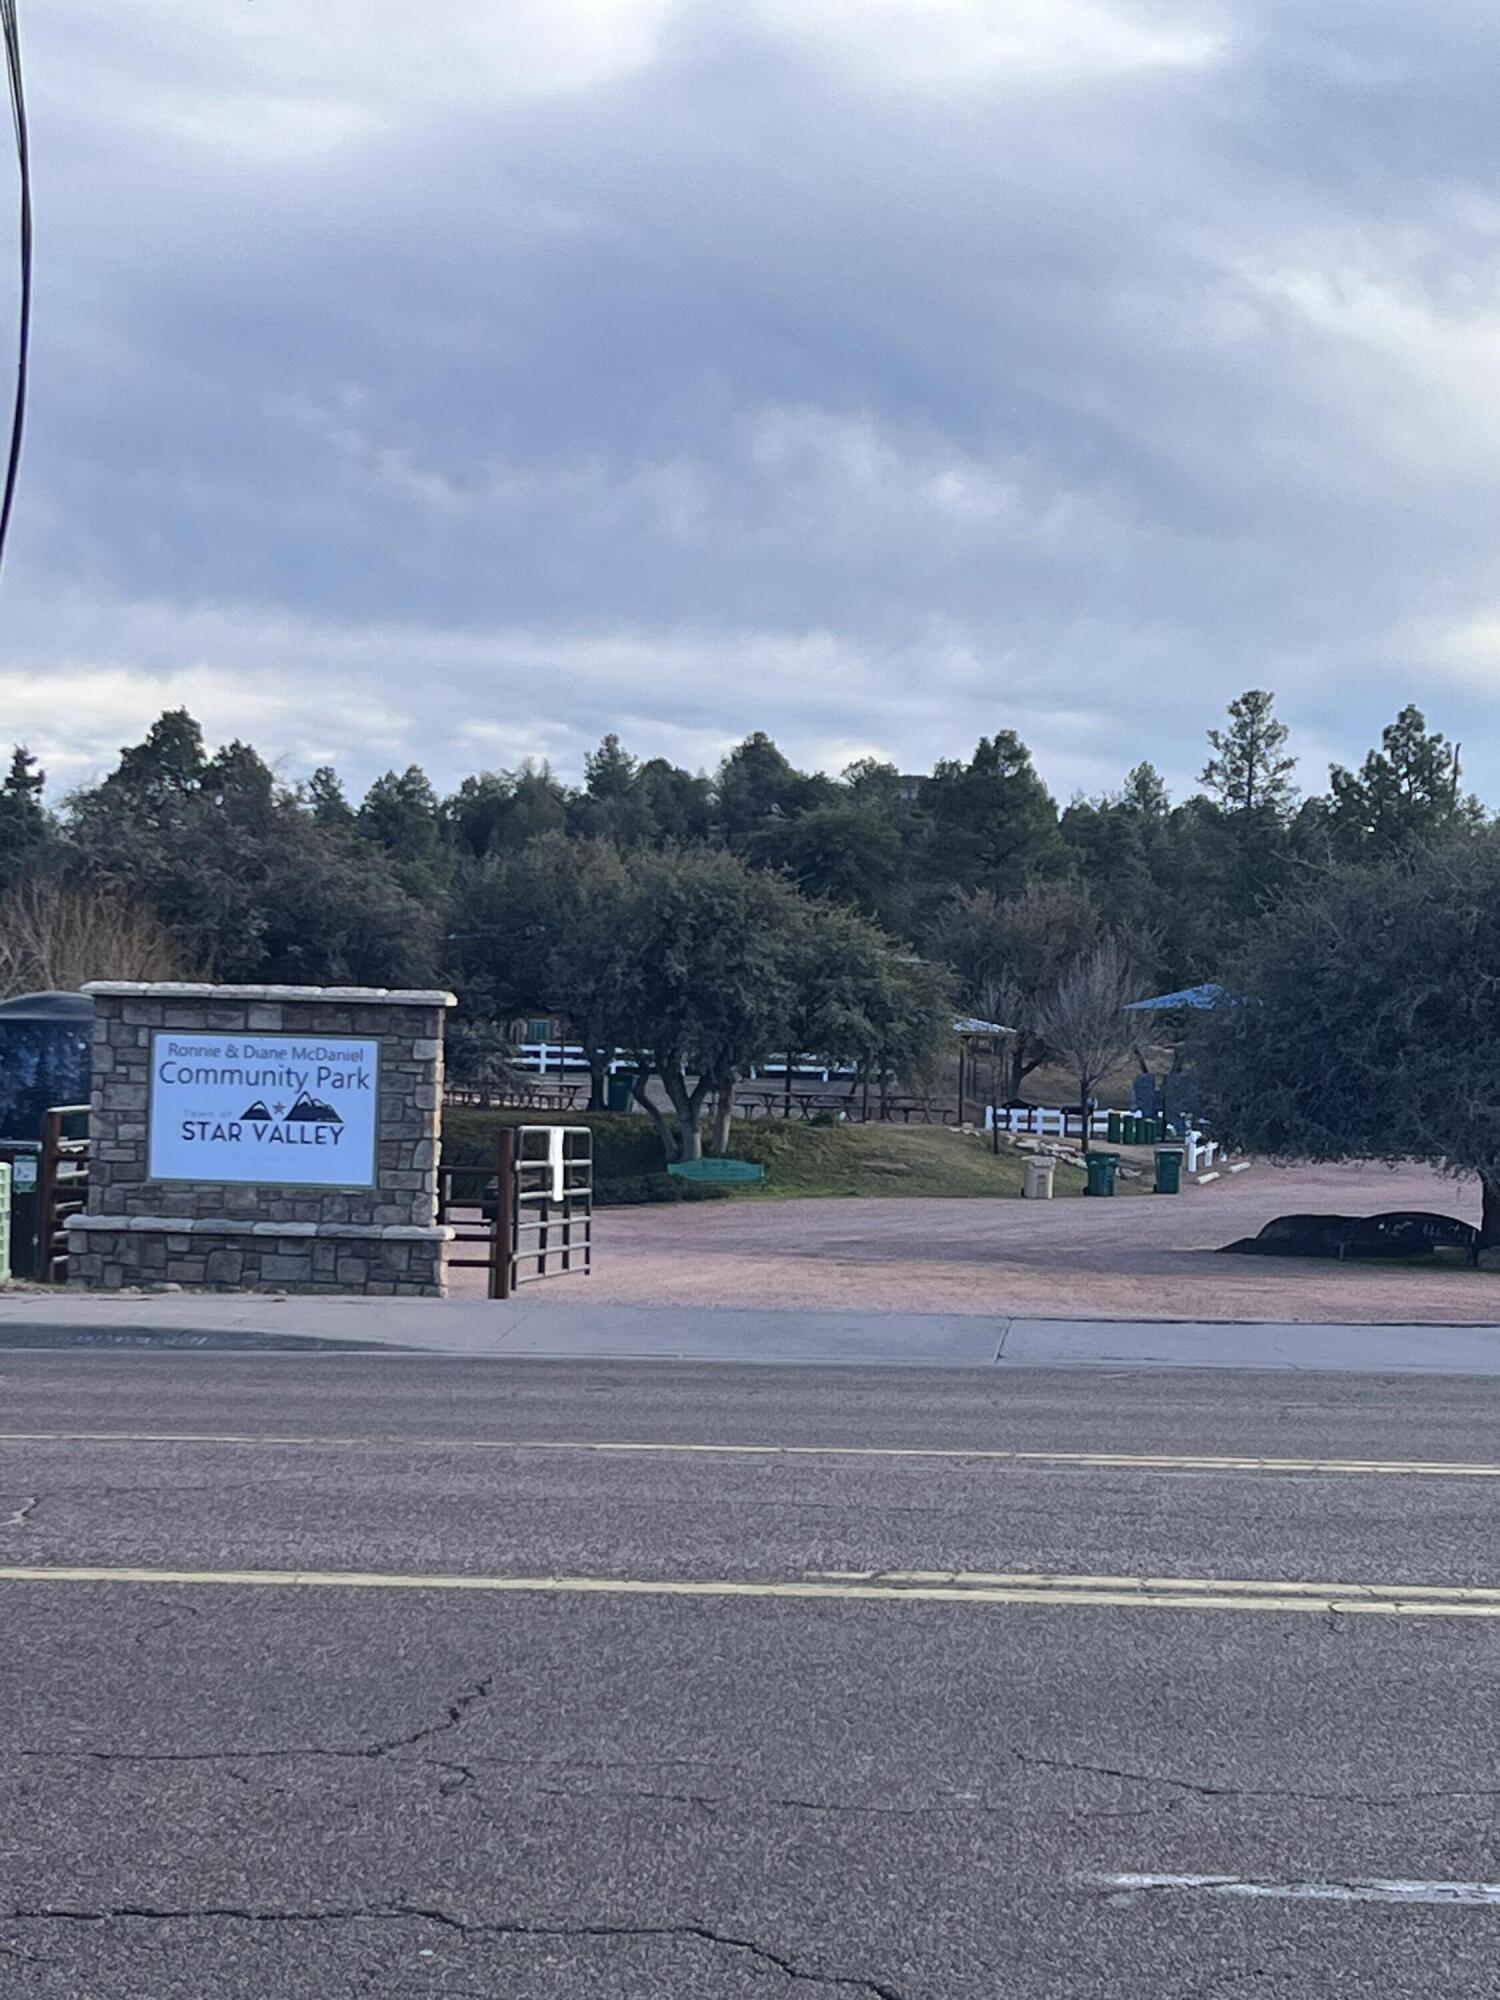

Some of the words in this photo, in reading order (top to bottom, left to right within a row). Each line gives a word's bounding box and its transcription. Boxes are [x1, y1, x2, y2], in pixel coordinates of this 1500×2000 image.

[168, 1042, 221, 1058] Ronnie
[225, 1044, 239, 1059] &
[243, 1045, 287, 1060] Diane
[292, 1047, 364, 1062] McDaniel
[159, 1061, 309, 1094] Community
[317, 1066, 370, 1090] Park
[181, 1121, 242, 1142] STAR
[253, 1123, 345, 1145] VALLEY
